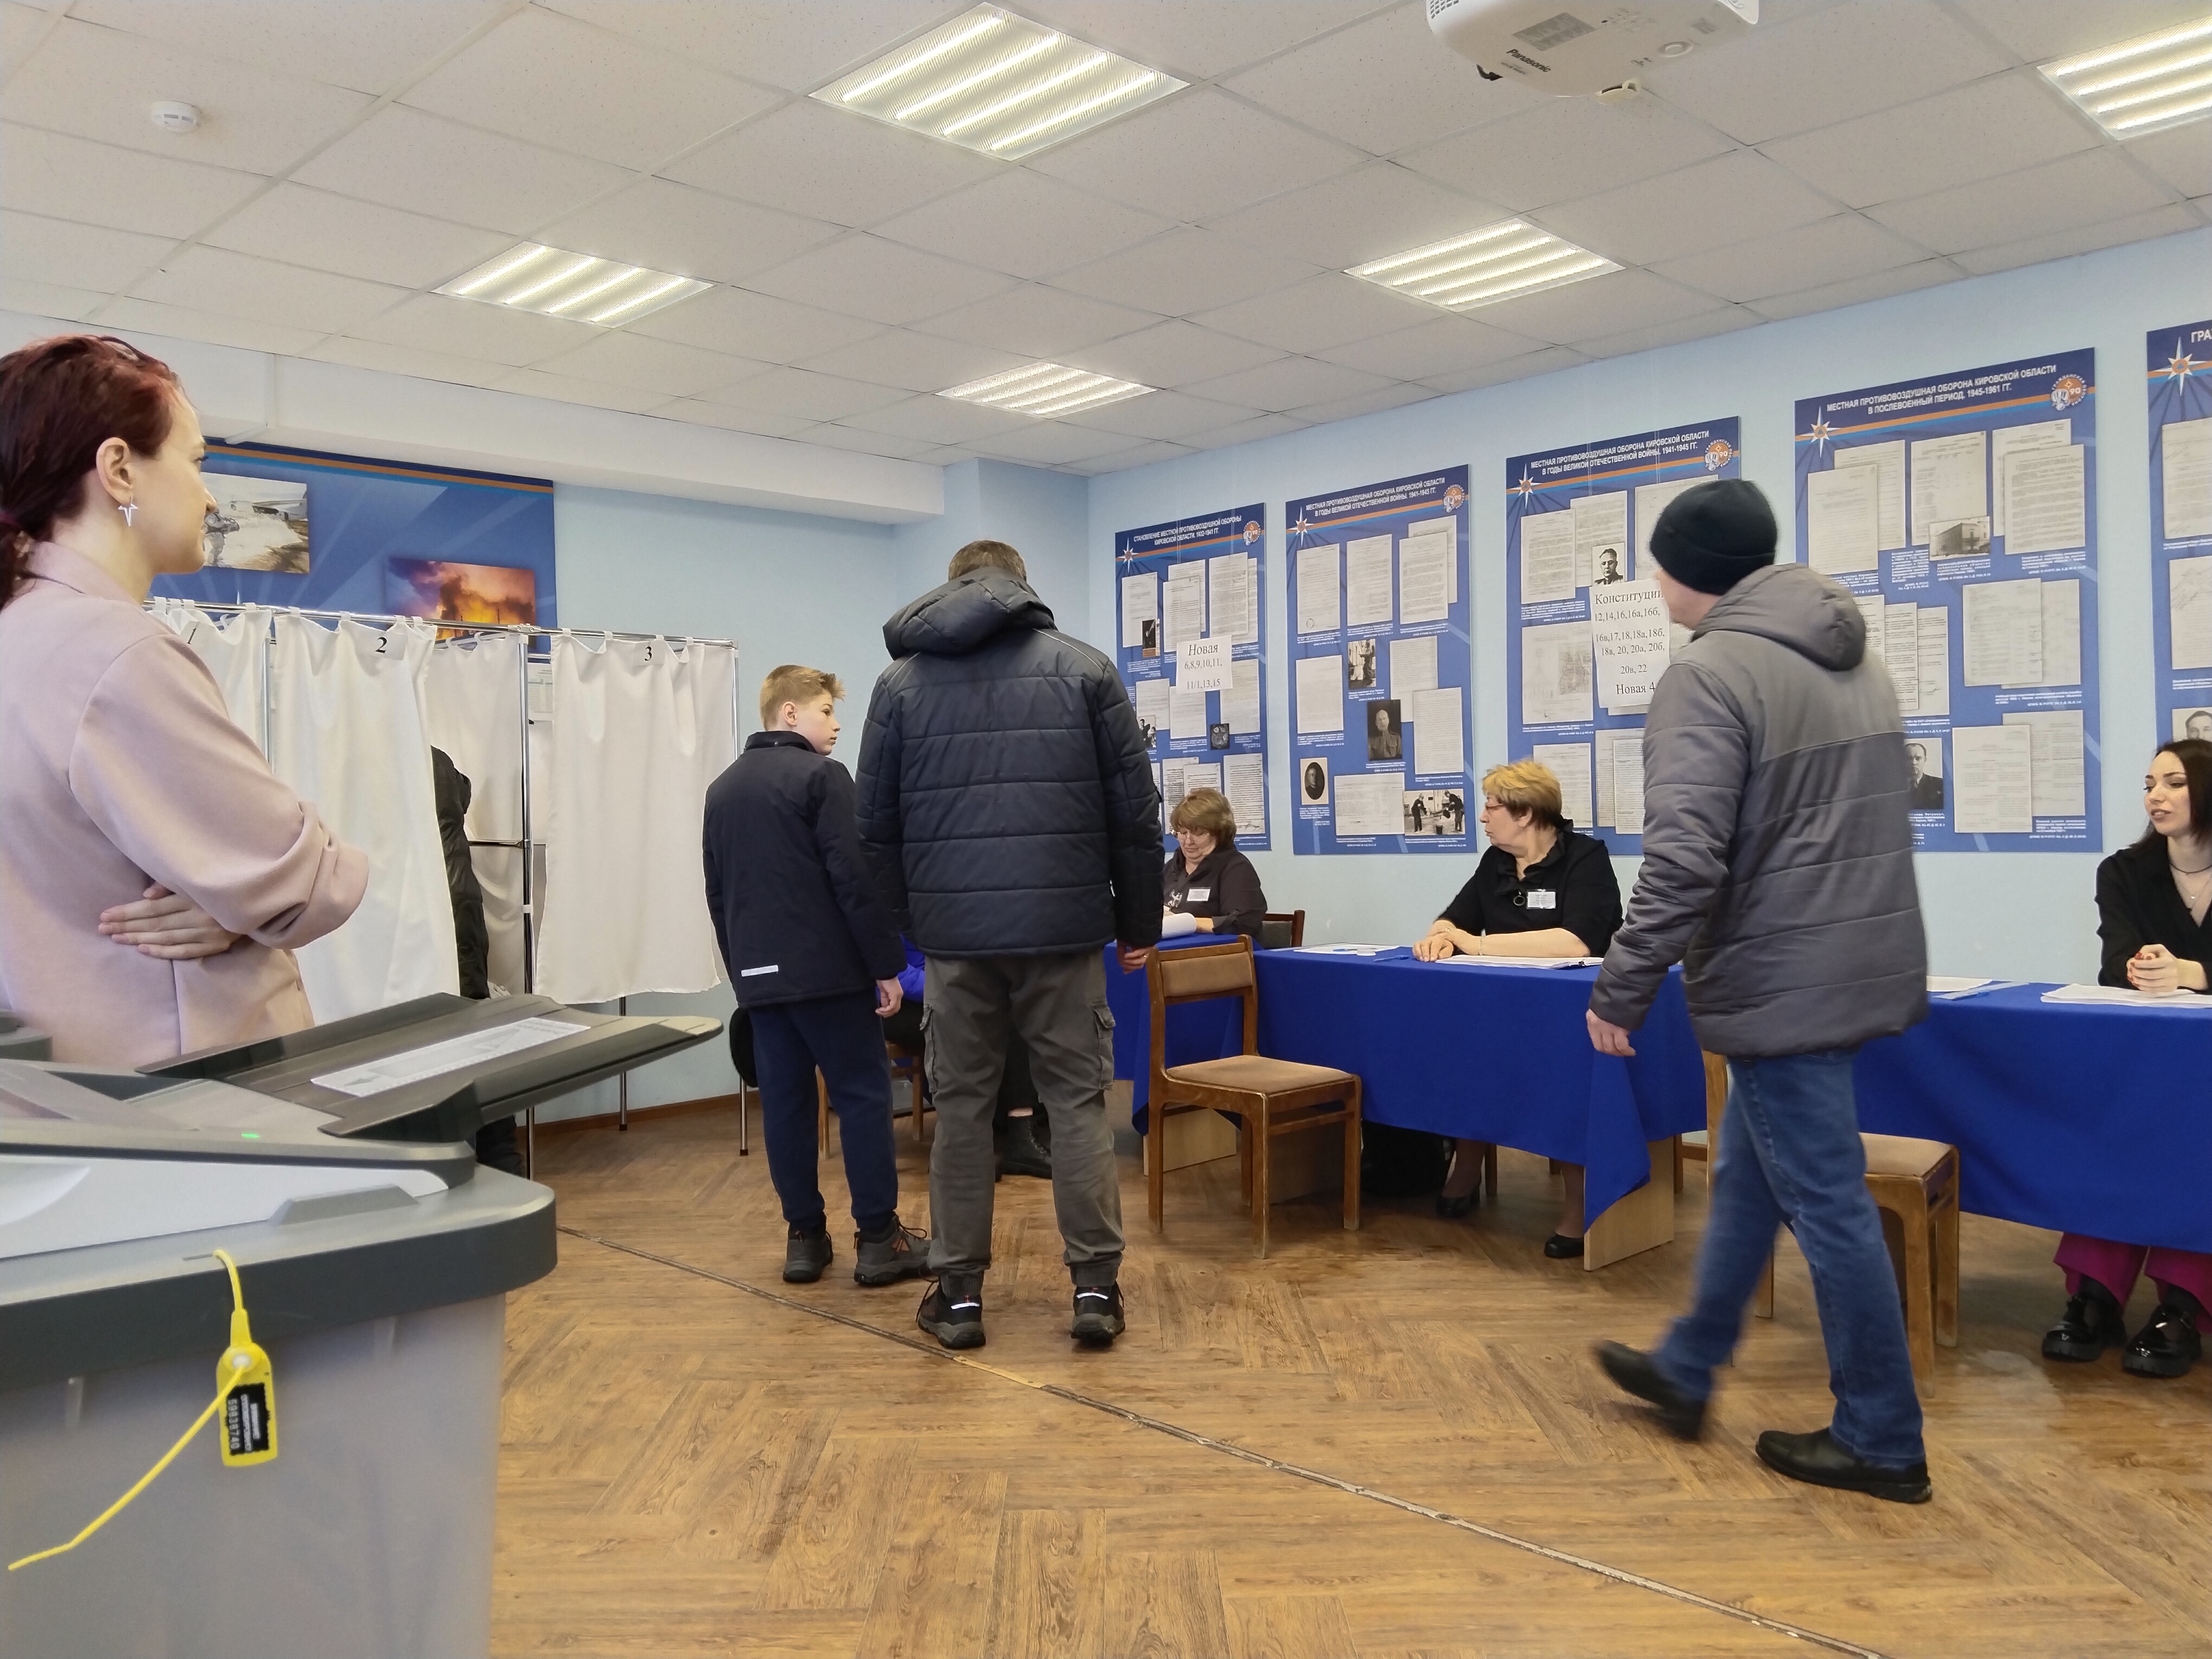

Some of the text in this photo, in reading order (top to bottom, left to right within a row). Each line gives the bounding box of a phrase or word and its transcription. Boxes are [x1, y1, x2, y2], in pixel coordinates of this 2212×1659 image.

[1506, 49, 1551, 72] Panasonic
[2191, 329, 2212, 343] ГРА
[1827, 364, 2056, 412] МЕСТНАЯ ПРОТИВОВОЗДУШНАЯ ОБОРОНА КИРОВСКОЙ ОБЛАСТИ
[2069, 387, 2081, 395] 90
[1874, 395, 1932, 413] ПОСЛЕВОЕННЫЙ
[1934, 391, 1965, 406] ПЕРИОД.
[2002, 383, 2012, 392] ГГ.
[1531, 430, 1709, 469] МЕСТНАЯ ПРОТИВОВОЗДУШНАЯ ОБОРОНА КИРОВСКОЙ ОБЛАСТИ
[1547, 465, 1562, 475] ГОДЫ
[1563, 460, 1589, 472] ВЕЛИКОЙ
[1590, 451, 1636, 467] ОТЕЧЕСТВЕННОЙ
[1637, 446, 1661, 459] ВОЙНЫ.
[1662, 443, 1689, 455] 1941-1945
[1306, 477, 1445, 511] МЕСТНАЯ ПРОТИВОВОЗДУШНАЯ ОБОРОНА КИРОВСКОЙ ОБЛАСТИ
[1331, 503, 1352, 514] ВЕЛИКОЙ
[1352, 495, 1390, 510] ОТЕЧЕСТВЕННОЙ
[1161, 528, 1178, 538] МЕСТНОЙ
[1179, 518, 1220, 535] ПРОТИВОВОЗДУШНОЙ
[1221, 516, 1242, 525] ОБОРОНЫ
[187, 628, 196, 645] 1
[375, 636, 387, 653] 2
[645, 646, 652, 661] 3
[1188, 644, 1218, 655] Новая
[1602, 642, 1665, 657] 18в, 20, 20а, 20б,
[1185, 658, 1222, 670] 6,8,9,10,11,
[1621, 664, 1647, 674] 20в, 22
[1187, 678, 1220, 690] 11/1,13,15
[1616, 684, 1646, 695] Новая
